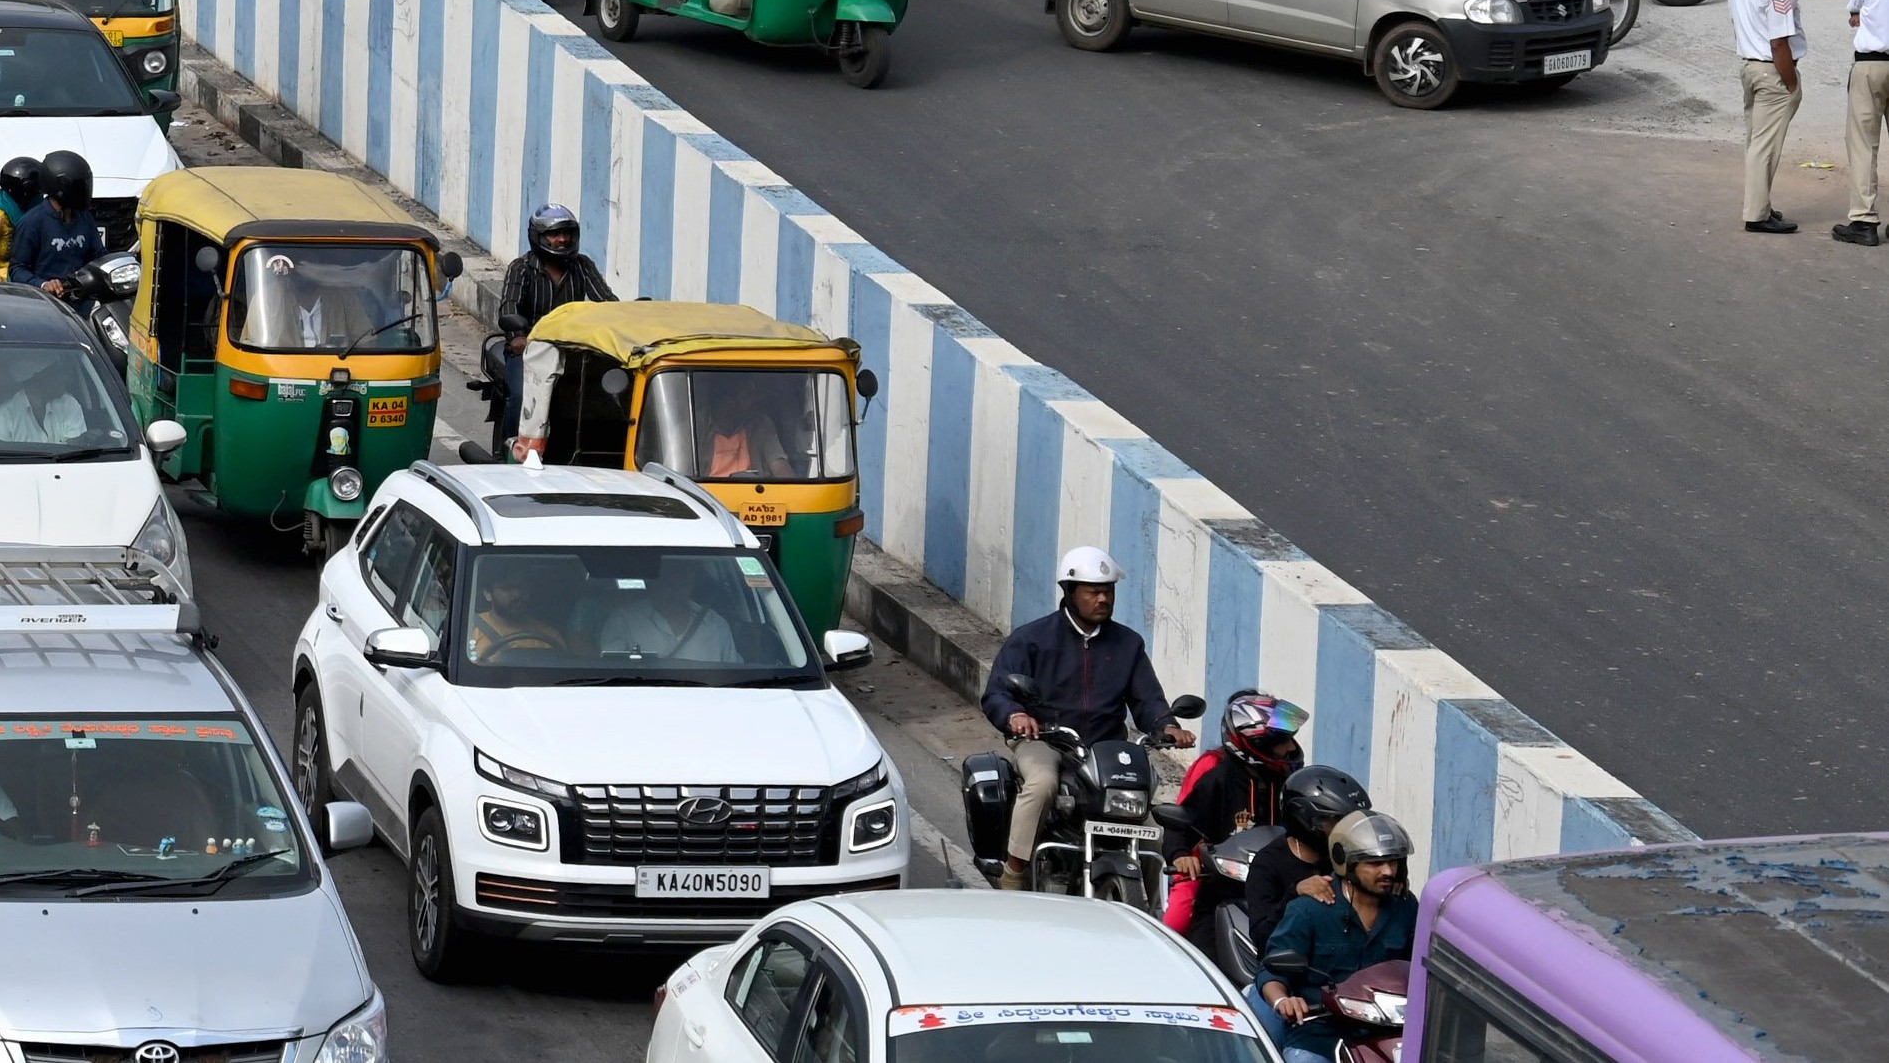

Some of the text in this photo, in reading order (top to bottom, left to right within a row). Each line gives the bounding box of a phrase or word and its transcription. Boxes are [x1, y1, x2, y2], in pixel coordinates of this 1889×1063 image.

[373, 400, 404, 411] KA 04
[370, 414, 404, 424] D 6340
[1092, 824, 1105, 834] KA
[657, 873, 761, 892] KA40N5090
[956, 1010, 985, 1024] ಶ್ರೀ
[1144, 1010, 1200, 1024] ಸ್ವಾಮಿ
